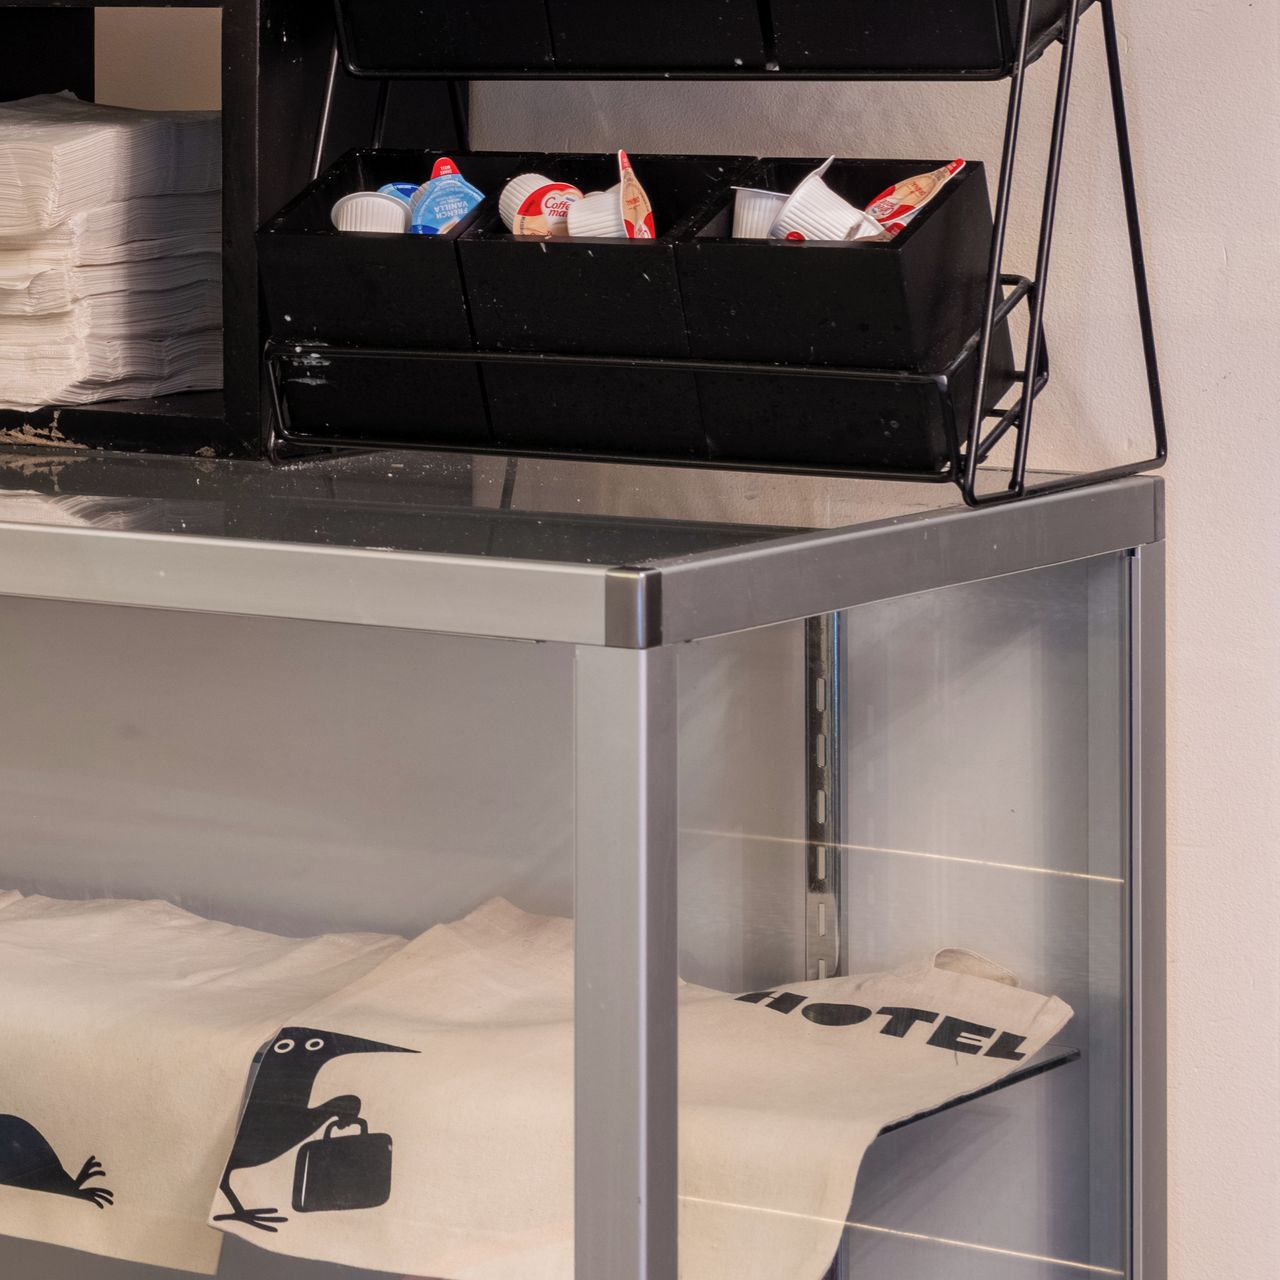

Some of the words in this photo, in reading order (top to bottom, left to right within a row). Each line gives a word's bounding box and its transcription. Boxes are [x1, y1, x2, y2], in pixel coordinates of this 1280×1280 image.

[434, 200, 469, 213] VANILLA
[544, 196, 570, 210] Coffe
[733, 990, 1027, 1061] HOTEL
